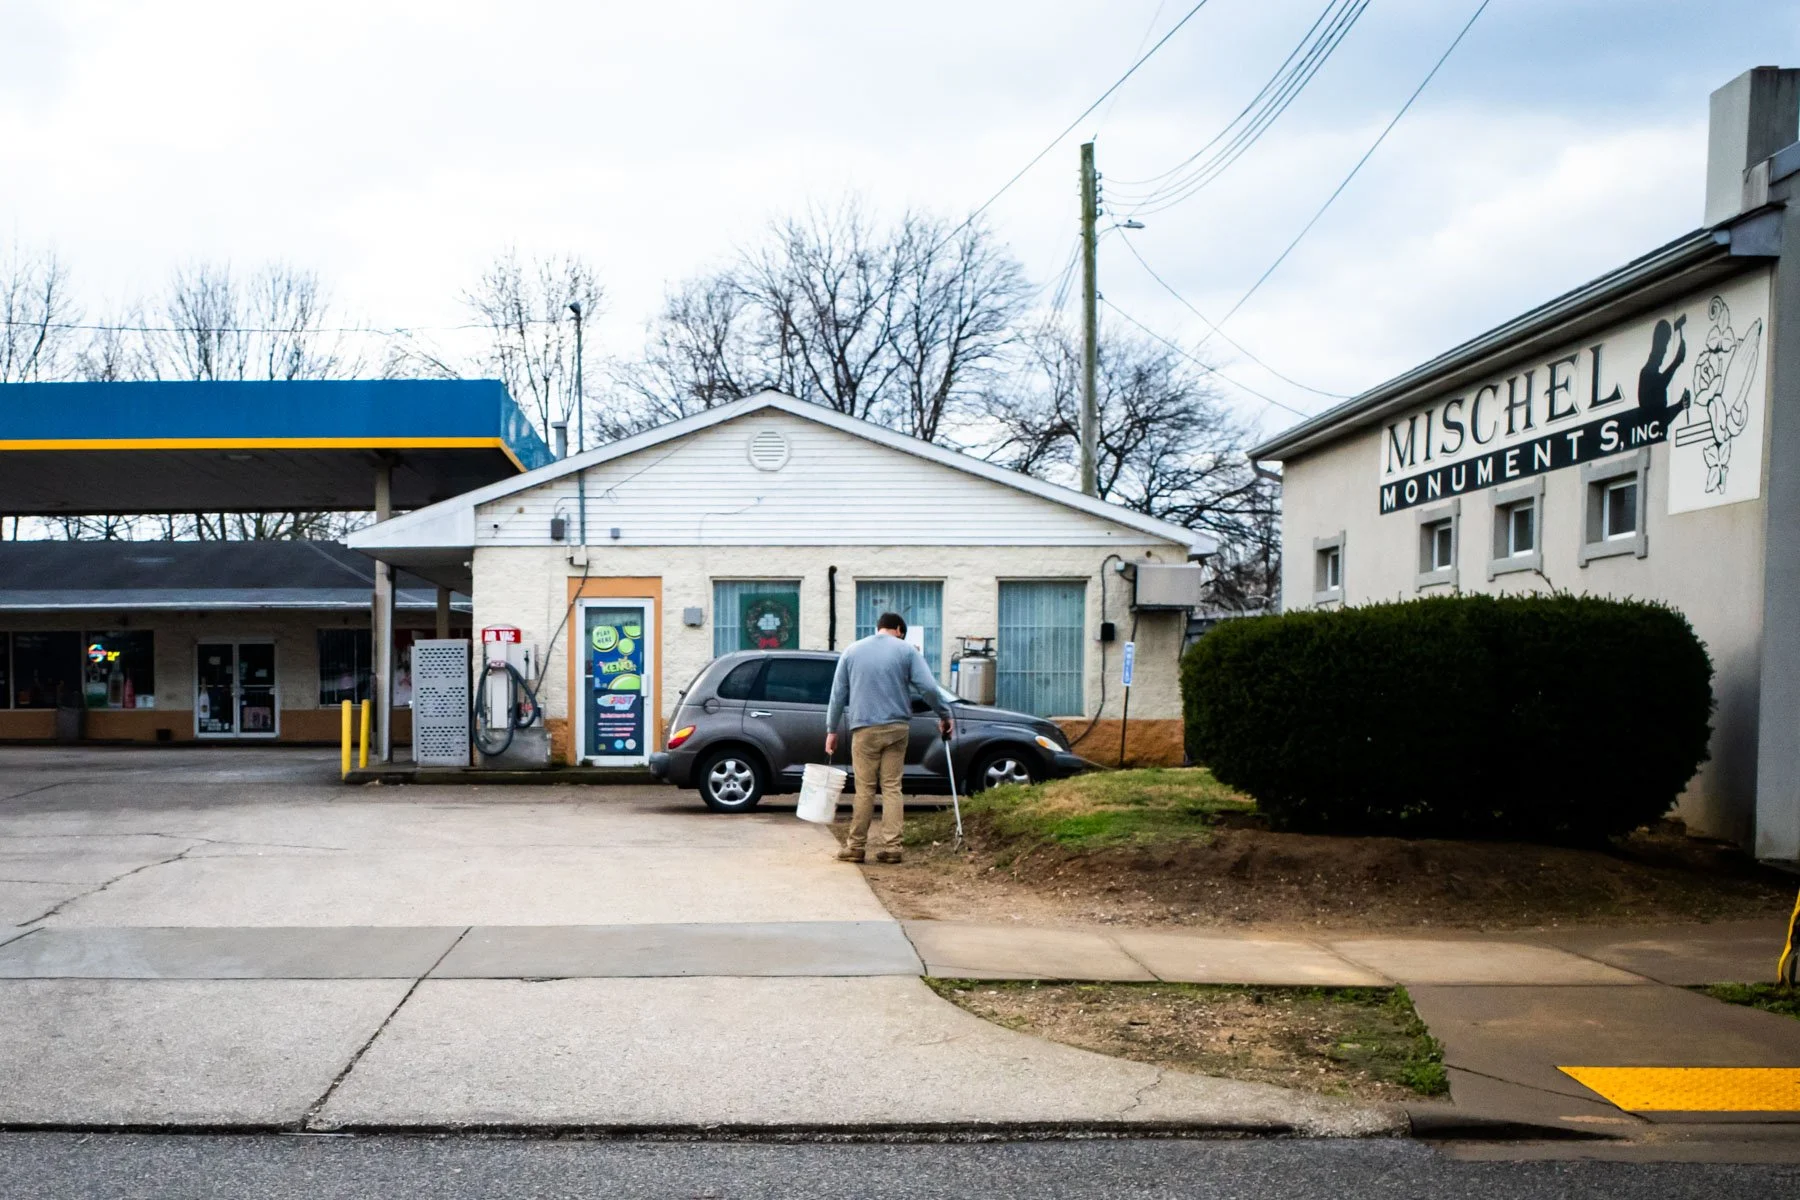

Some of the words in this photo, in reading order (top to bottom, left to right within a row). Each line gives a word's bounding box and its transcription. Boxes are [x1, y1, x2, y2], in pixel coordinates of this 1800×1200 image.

[1386, 343, 1624, 475] MISCHEL
[1631, 420, 1663, 445] INC.
[484, 630, 497, 642] AIR
[499, 630, 515, 642] VAC
[603, 660, 633, 674] KENO
